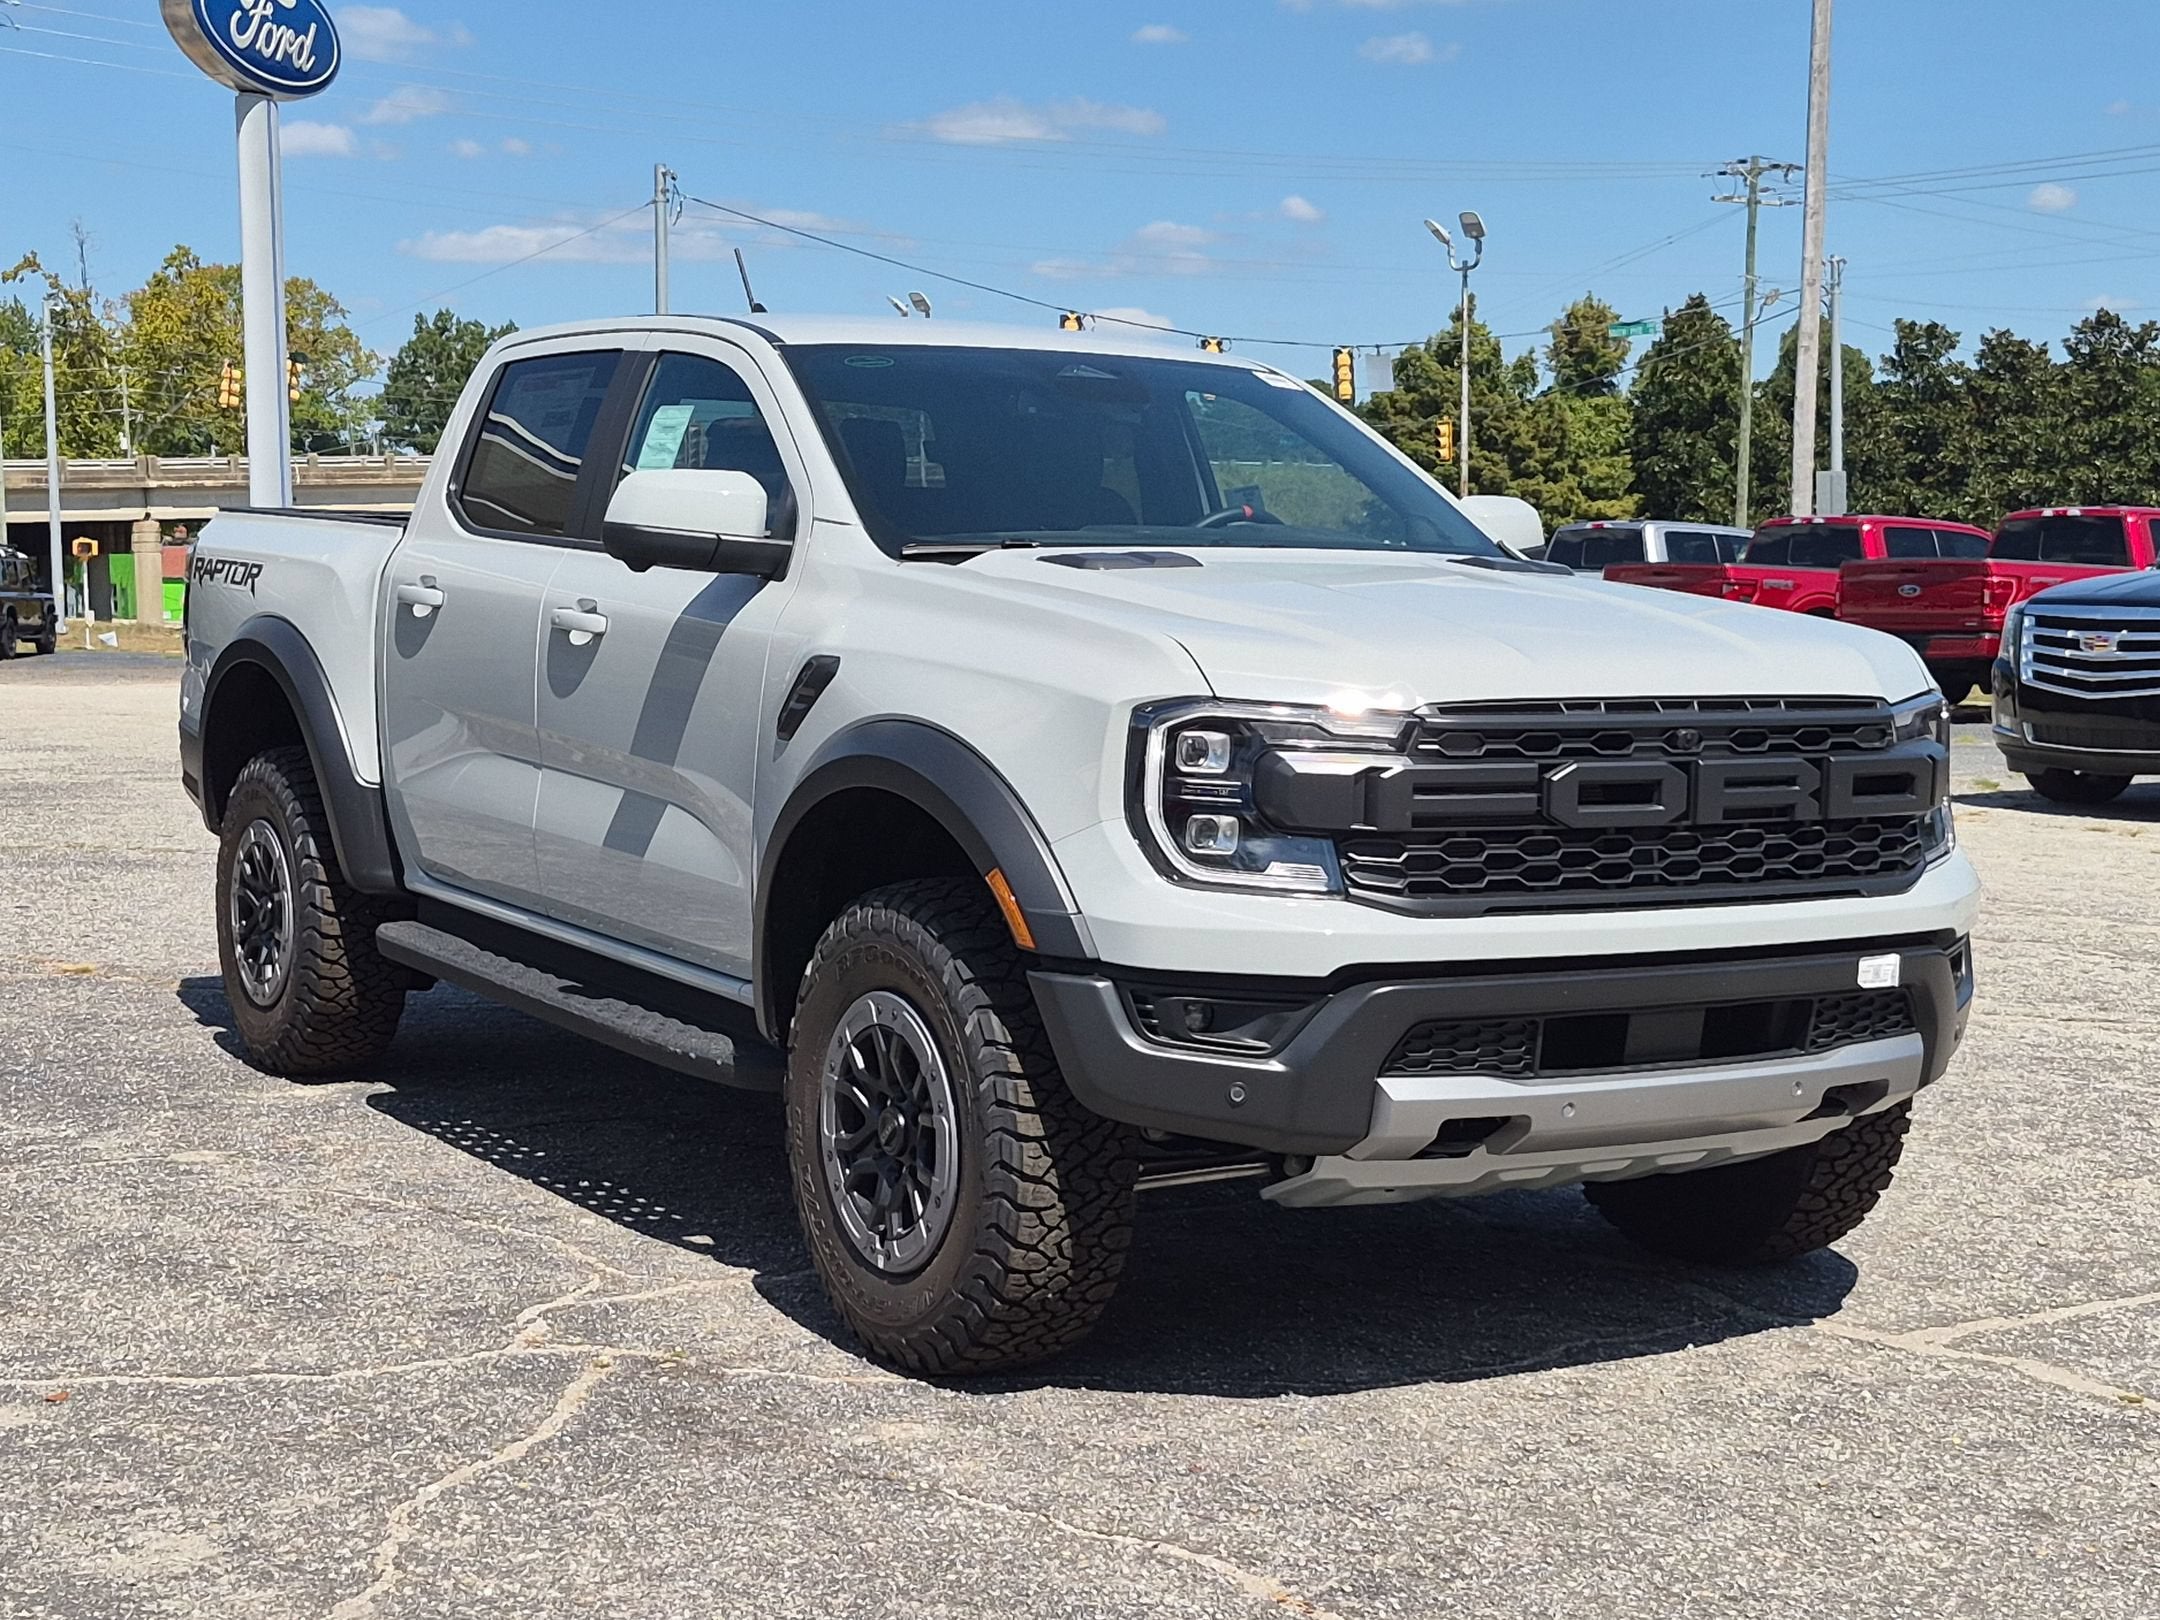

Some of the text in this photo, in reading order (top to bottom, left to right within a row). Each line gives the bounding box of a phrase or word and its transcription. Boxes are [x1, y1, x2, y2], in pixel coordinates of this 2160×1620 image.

[230, 0, 317, 72] Ford
[193, 556, 264, 600] RAPTOR
[1362, 755, 1933, 834] FORD
